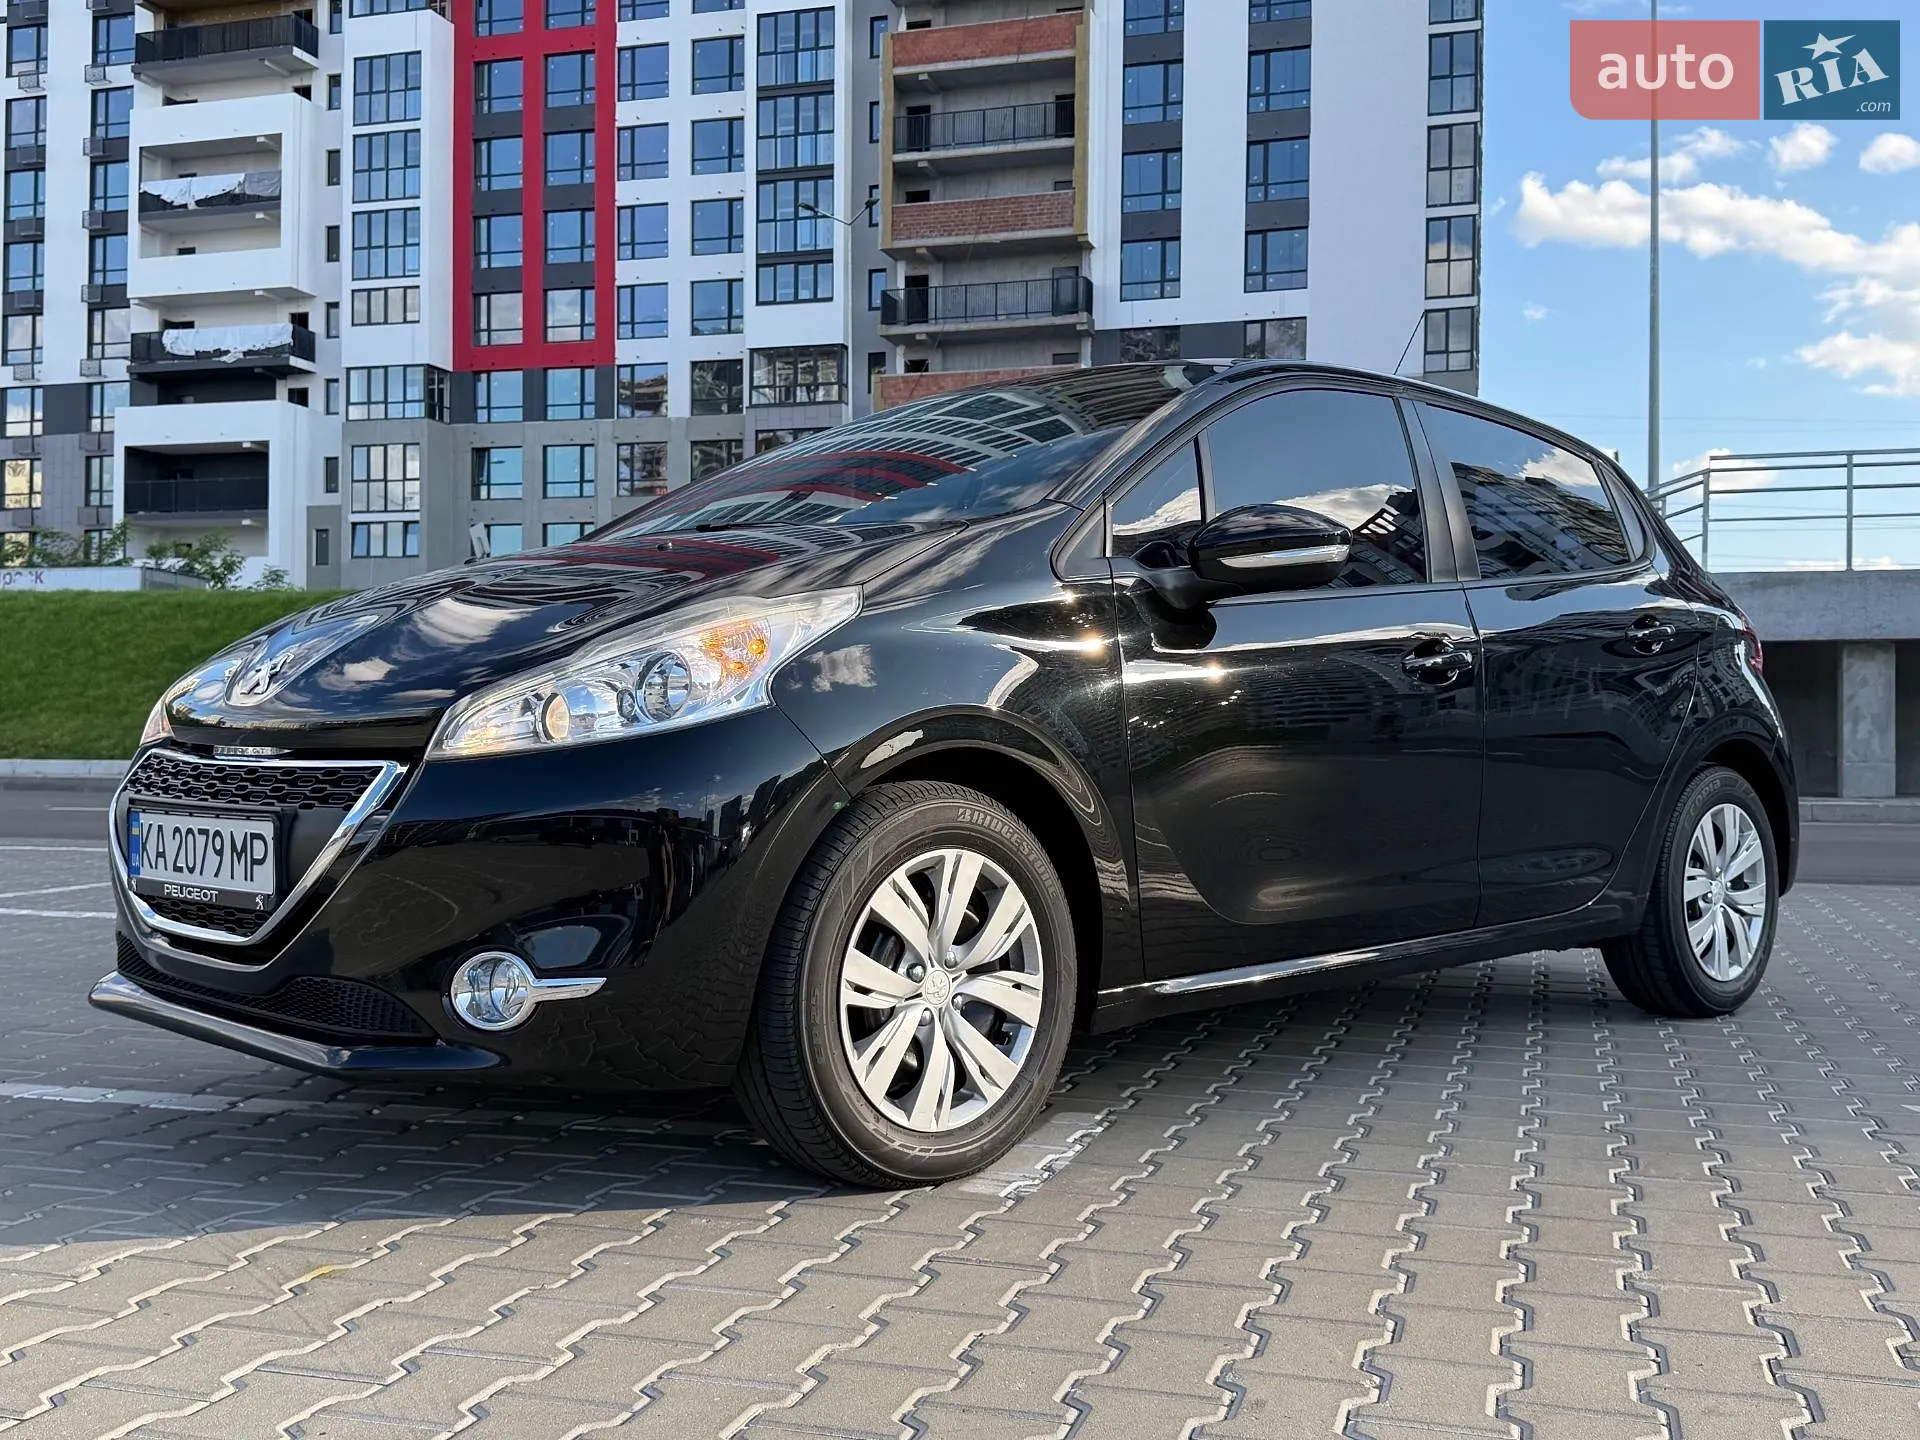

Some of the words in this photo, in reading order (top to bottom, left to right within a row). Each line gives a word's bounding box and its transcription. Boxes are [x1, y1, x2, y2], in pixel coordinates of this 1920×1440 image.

[131, 852, 140, 868] UA
[140, 821, 168, 872] KA
[172, 825, 225, 878] 2079
[230, 829, 269, 883] MP
[957, 807, 1058, 898] BRIDGESTONE
[163, 883, 219, 903] PEUGEOT
